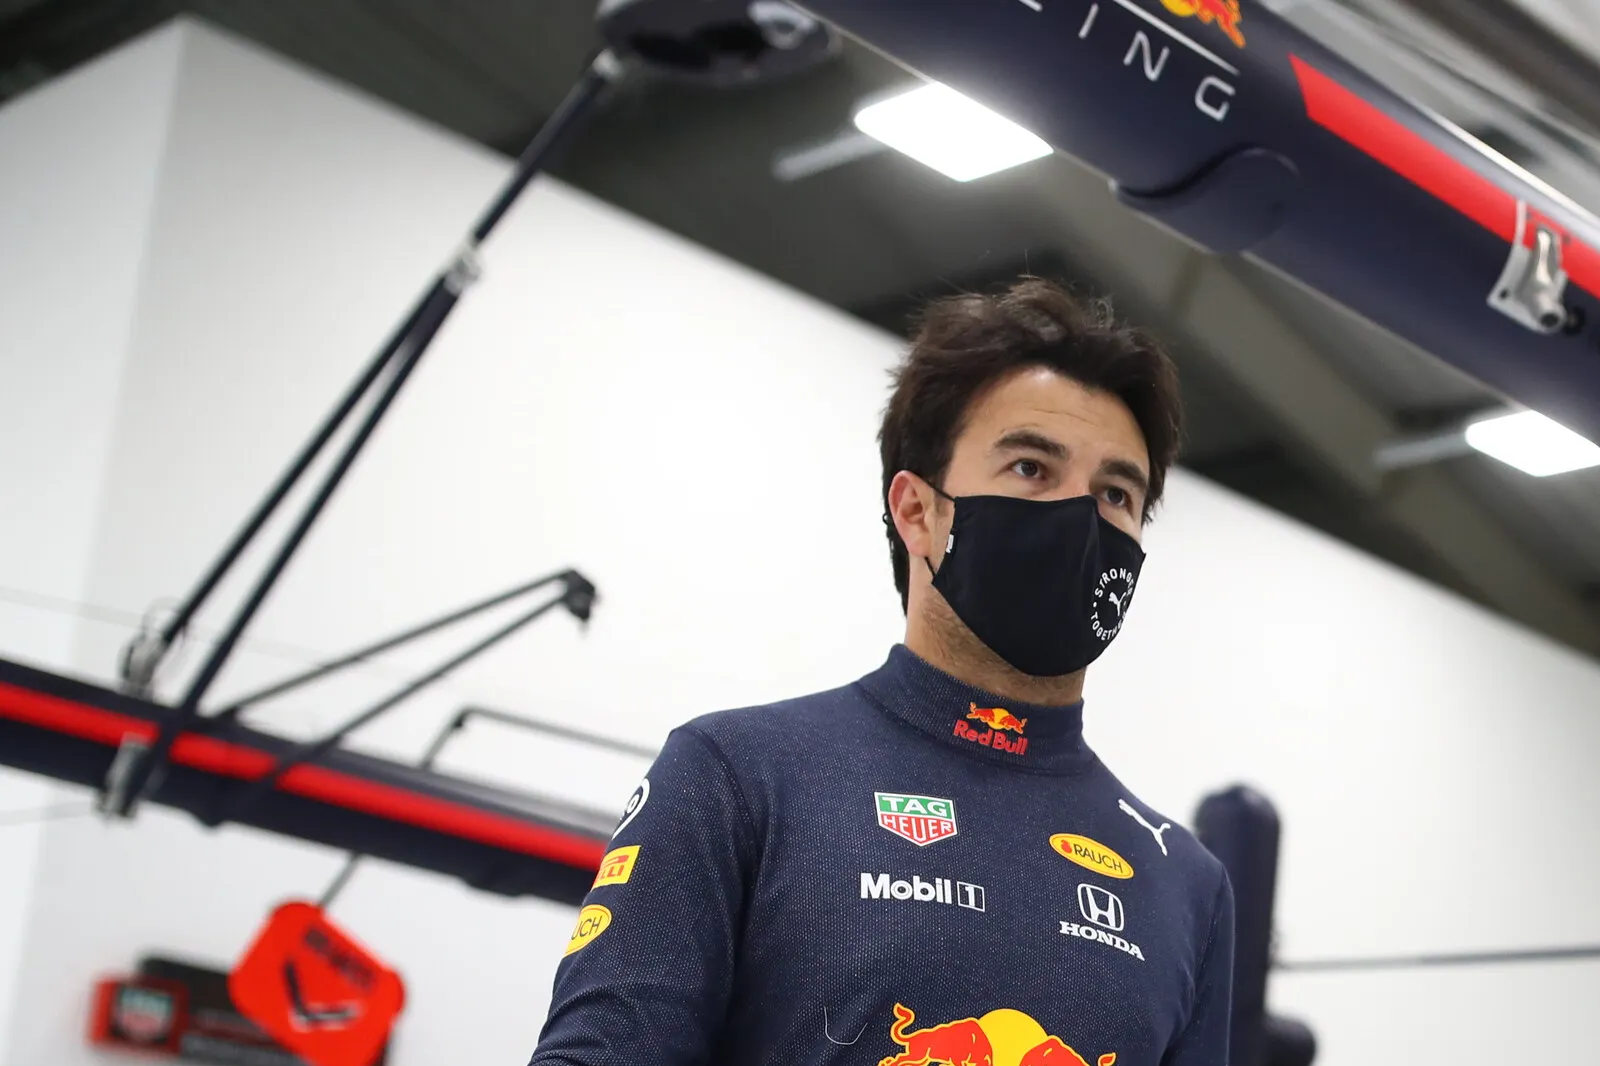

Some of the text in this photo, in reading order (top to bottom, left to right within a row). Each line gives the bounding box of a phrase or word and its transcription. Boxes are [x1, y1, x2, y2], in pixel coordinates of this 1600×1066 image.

[953, 719, 1028, 756] Red Bull
[881, 796, 948, 817] TAG
[883, 815, 952, 841] HEUER
[1073, 843, 1124, 874] RAUCH
[860, 872, 952, 904] Mobil
[1059, 920, 1146, 961] HONDA
